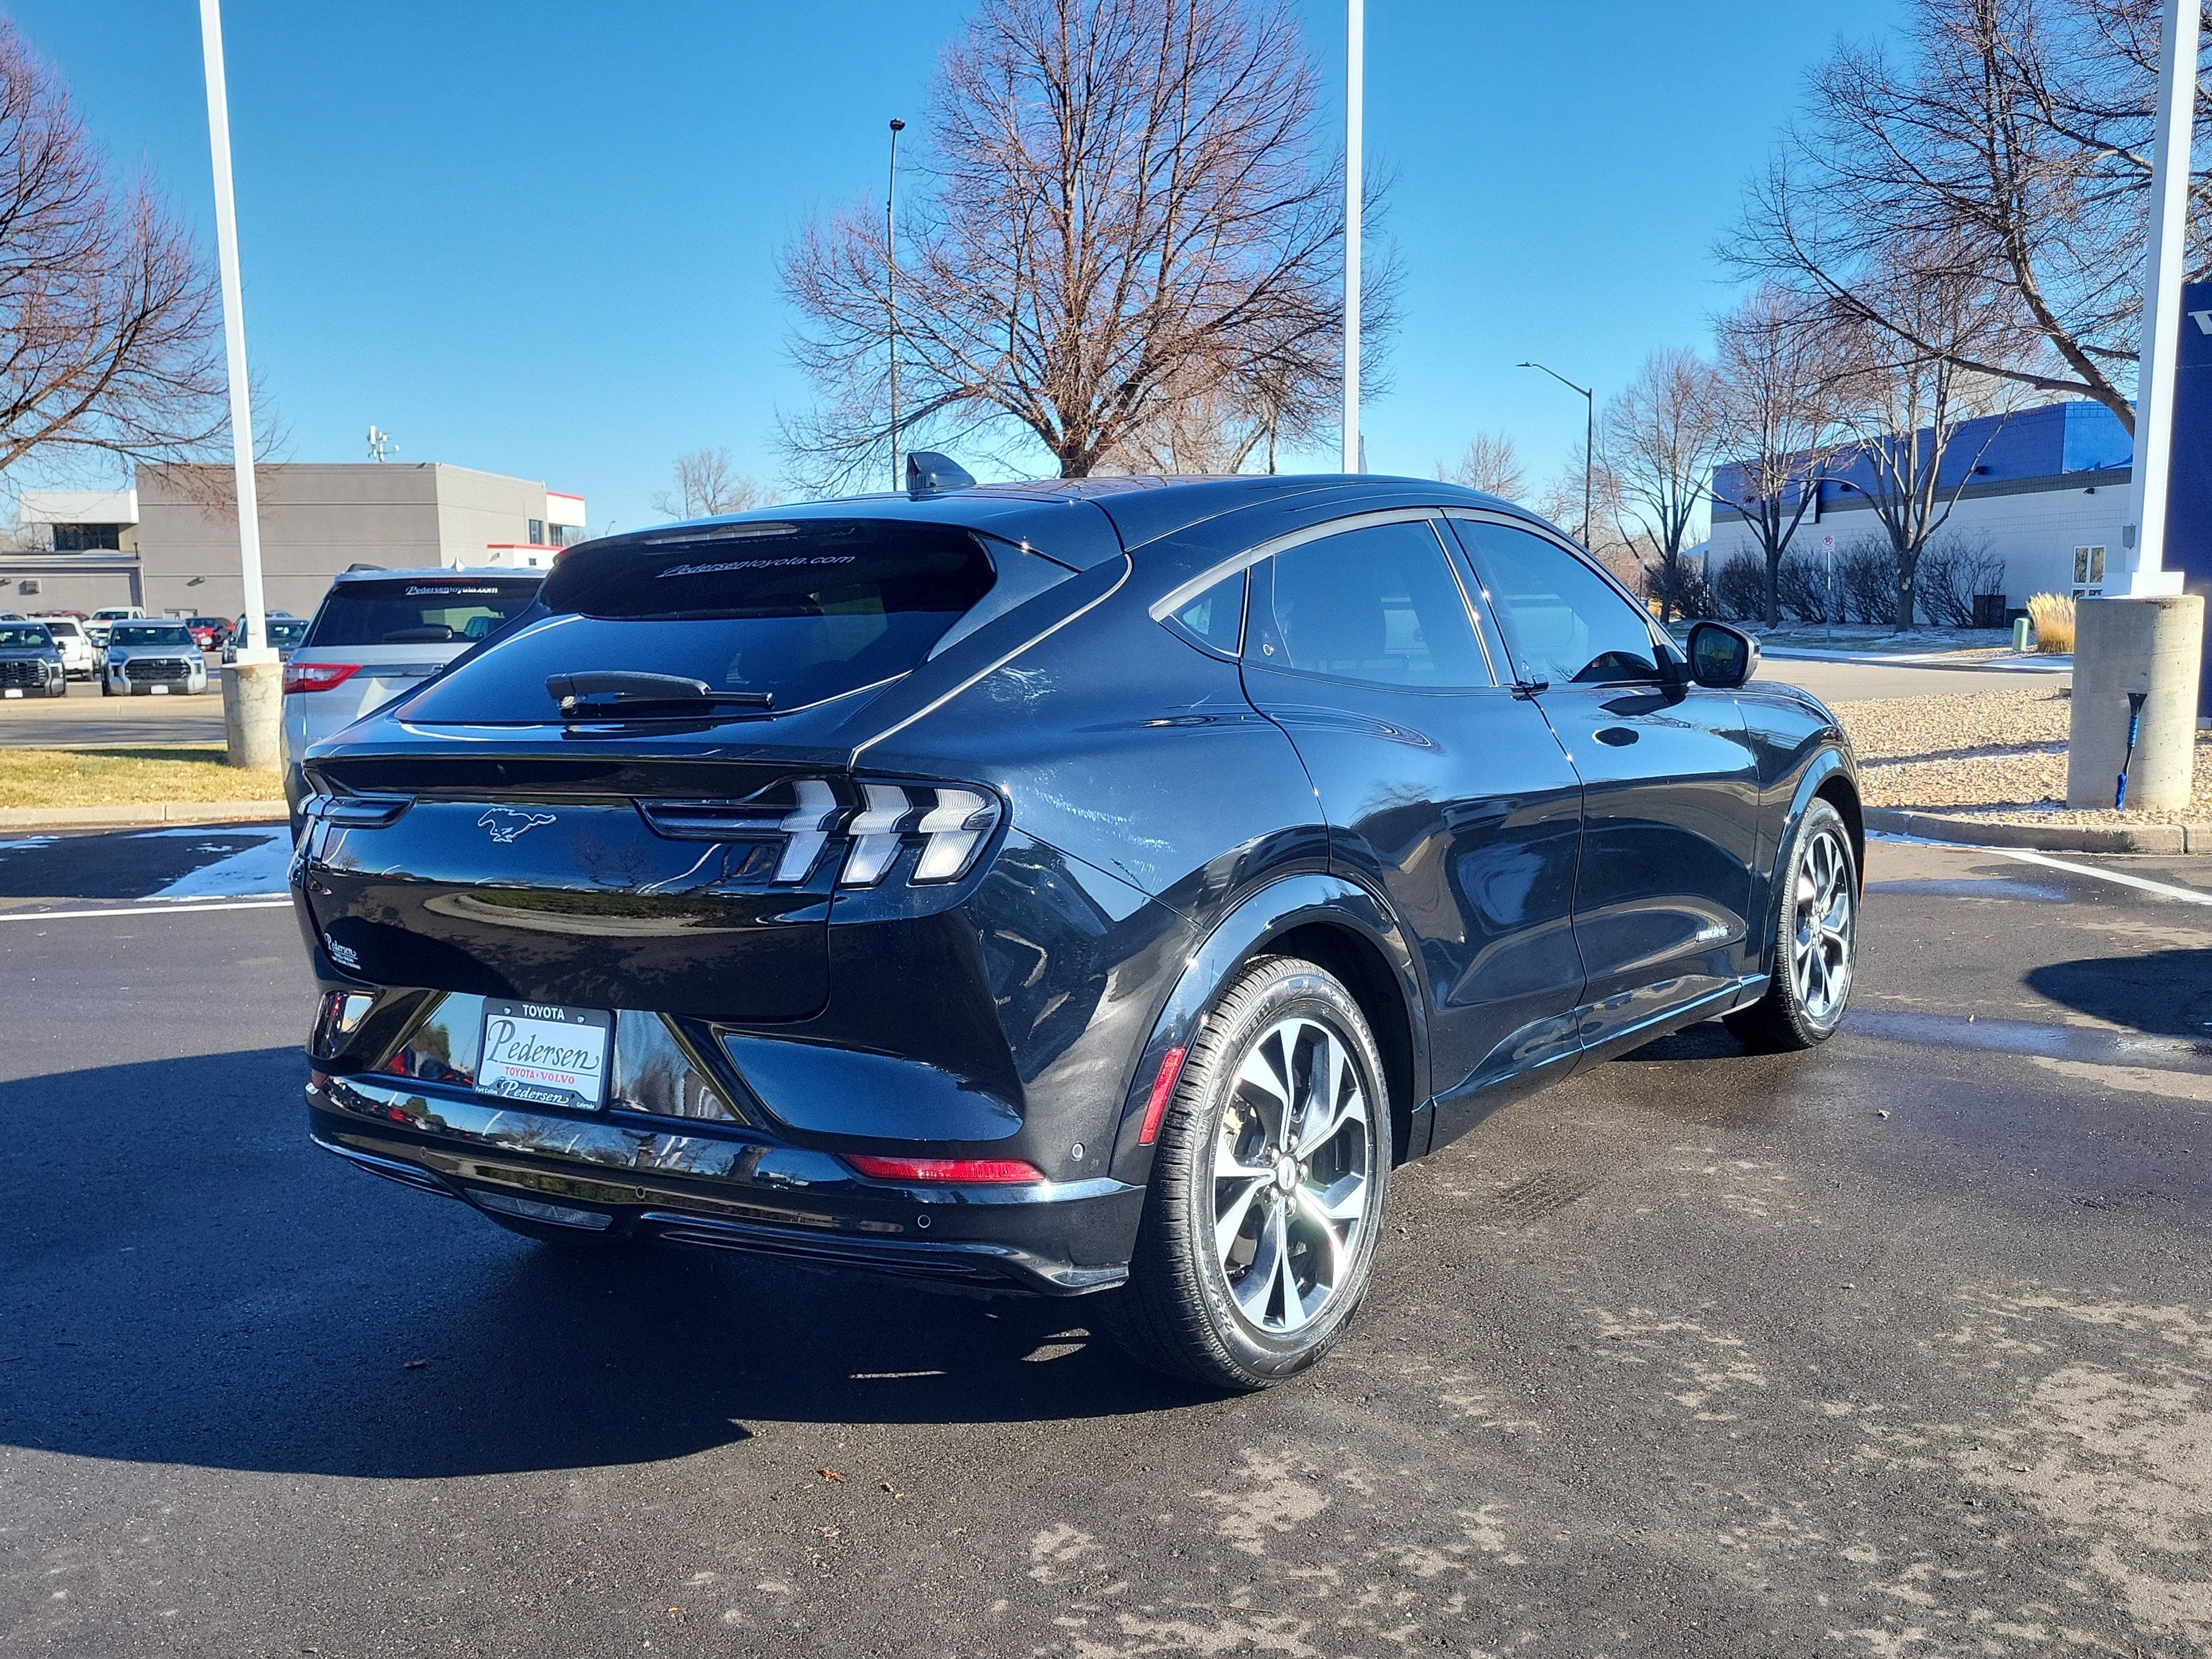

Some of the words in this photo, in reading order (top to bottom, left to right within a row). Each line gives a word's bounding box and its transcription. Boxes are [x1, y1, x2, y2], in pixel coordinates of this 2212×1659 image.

[522, 1004, 565, 1020] TOYOTA
[487, 1020, 599, 1070] Pedersen
[505, 1066, 534, 1078] TOYOTA
[540, 1072, 575, 1084] VOLVO
[500, 1081, 569, 1104] Pedersen
